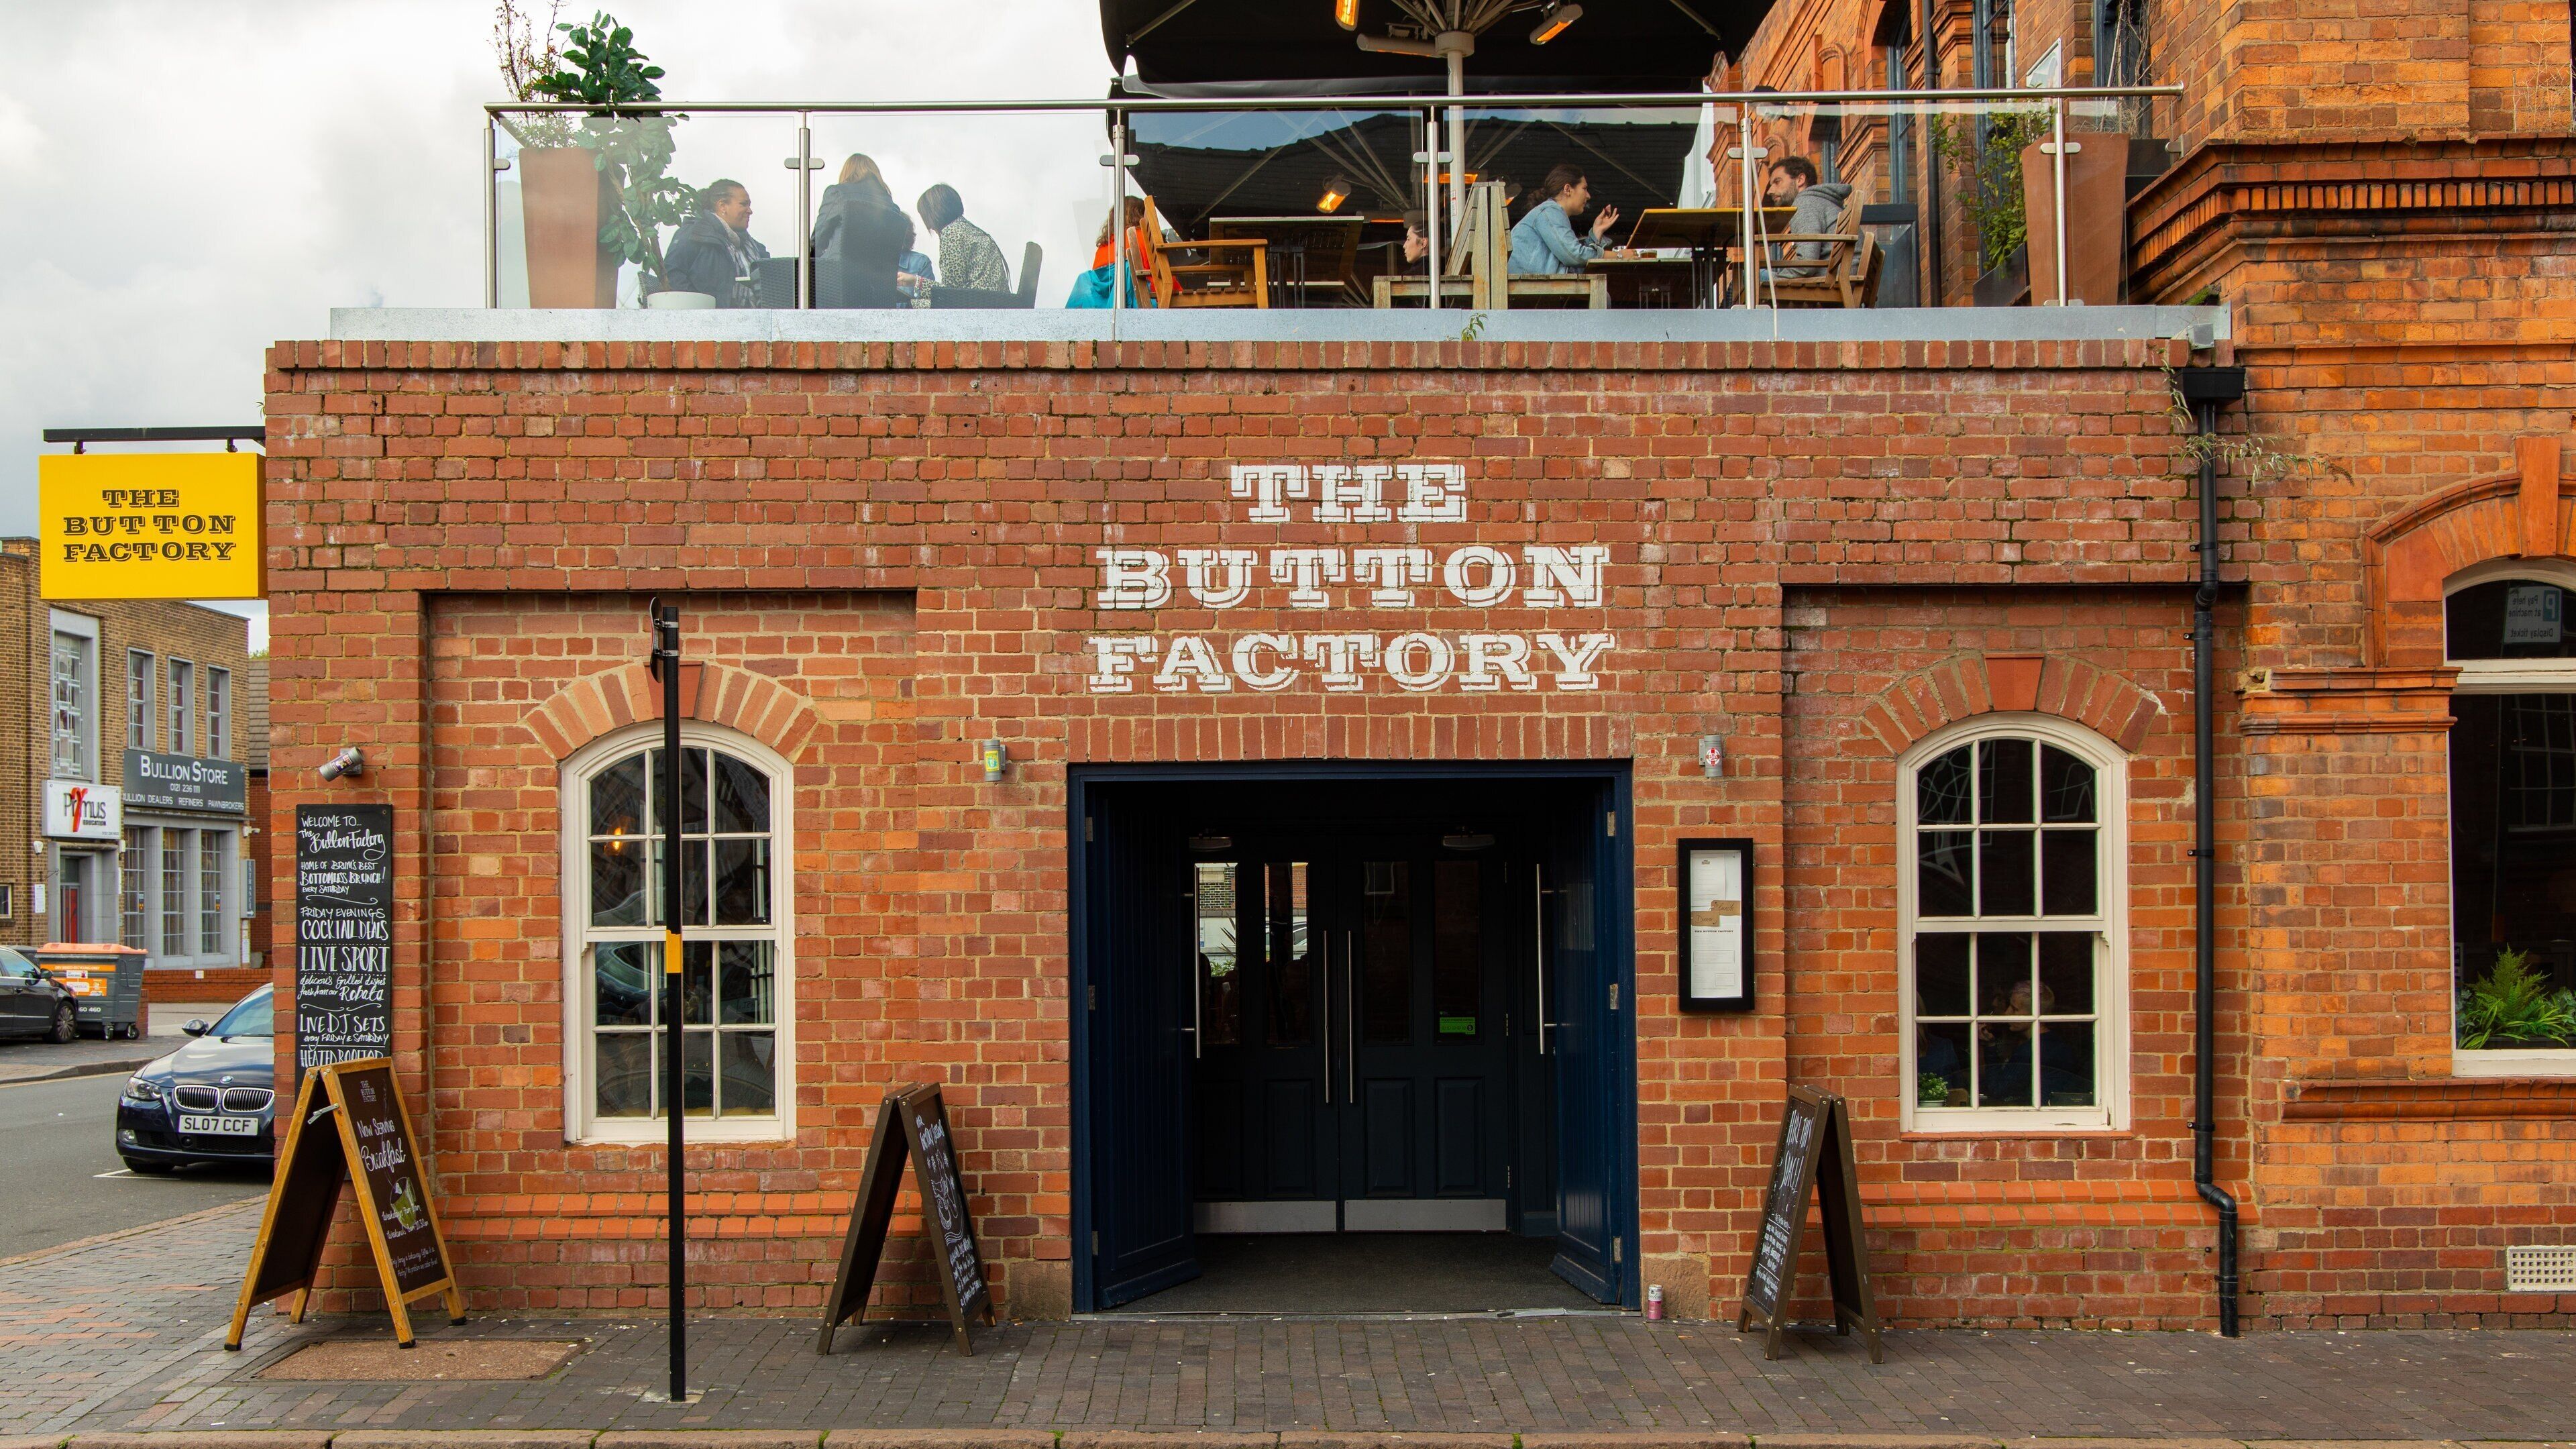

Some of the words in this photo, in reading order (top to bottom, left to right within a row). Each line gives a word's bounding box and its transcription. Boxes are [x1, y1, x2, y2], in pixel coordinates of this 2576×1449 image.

[102, 489, 179, 508] THE
[1230, 464, 1467, 523] THE
[63, 515, 236, 535] BUTTON
[63, 541, 236, 561] FACTORY
[1095, 545, 1611, 610] BUTTON
[1087, 633, 1615, 692] FACTORY
[148, 794, 173, 805] DEALERS
[178, 797, 203, 807] REFINERS
[208, 800, 244, 810] PAWNBROKERS
[301, 815, 341, 827] WELCOME
[310, 830, 350, 853] Button
[348, 829, 386, 861] Factory
[301, 861, 319, 870] HOME
[320, 861, 327, 869] OF
[358, 861, 378, 870] BEST
[300, 871, 347, 885] BOTTOMLESS
[302, 886, 317, 894] EVERY
[319, 885, 349, 894] SATURDAY
[301, 906, 333, 918] FRIDAY
[336, 908, 385, 924] EVENINGS
[302, 919, 358, 940] COCKTAIL
[358, 919, 389, 941] DEALS
[301, 947, 337, 971] LIVE
[341, 947, 390, 971] SPORT
[300, 975, 333, 985] delicious
[339, 985, 384, 1001] Robata
[300, 1014, 325, 1033] LIVE
[327, 1012, 350, 1034] DJ
[321, 1033, 345, 1044] FRIDAY
[354, 1034, 389, 1044] SATURDAY
[360, 1080, 370, 1089] THE
[361, 1088, 376, 1097] BUTTON
[184, 1118, 220, 1130] SL07
[223, 1119, 251, 1132] CCF
[361, 1138, 406, 1173] Breakfast
